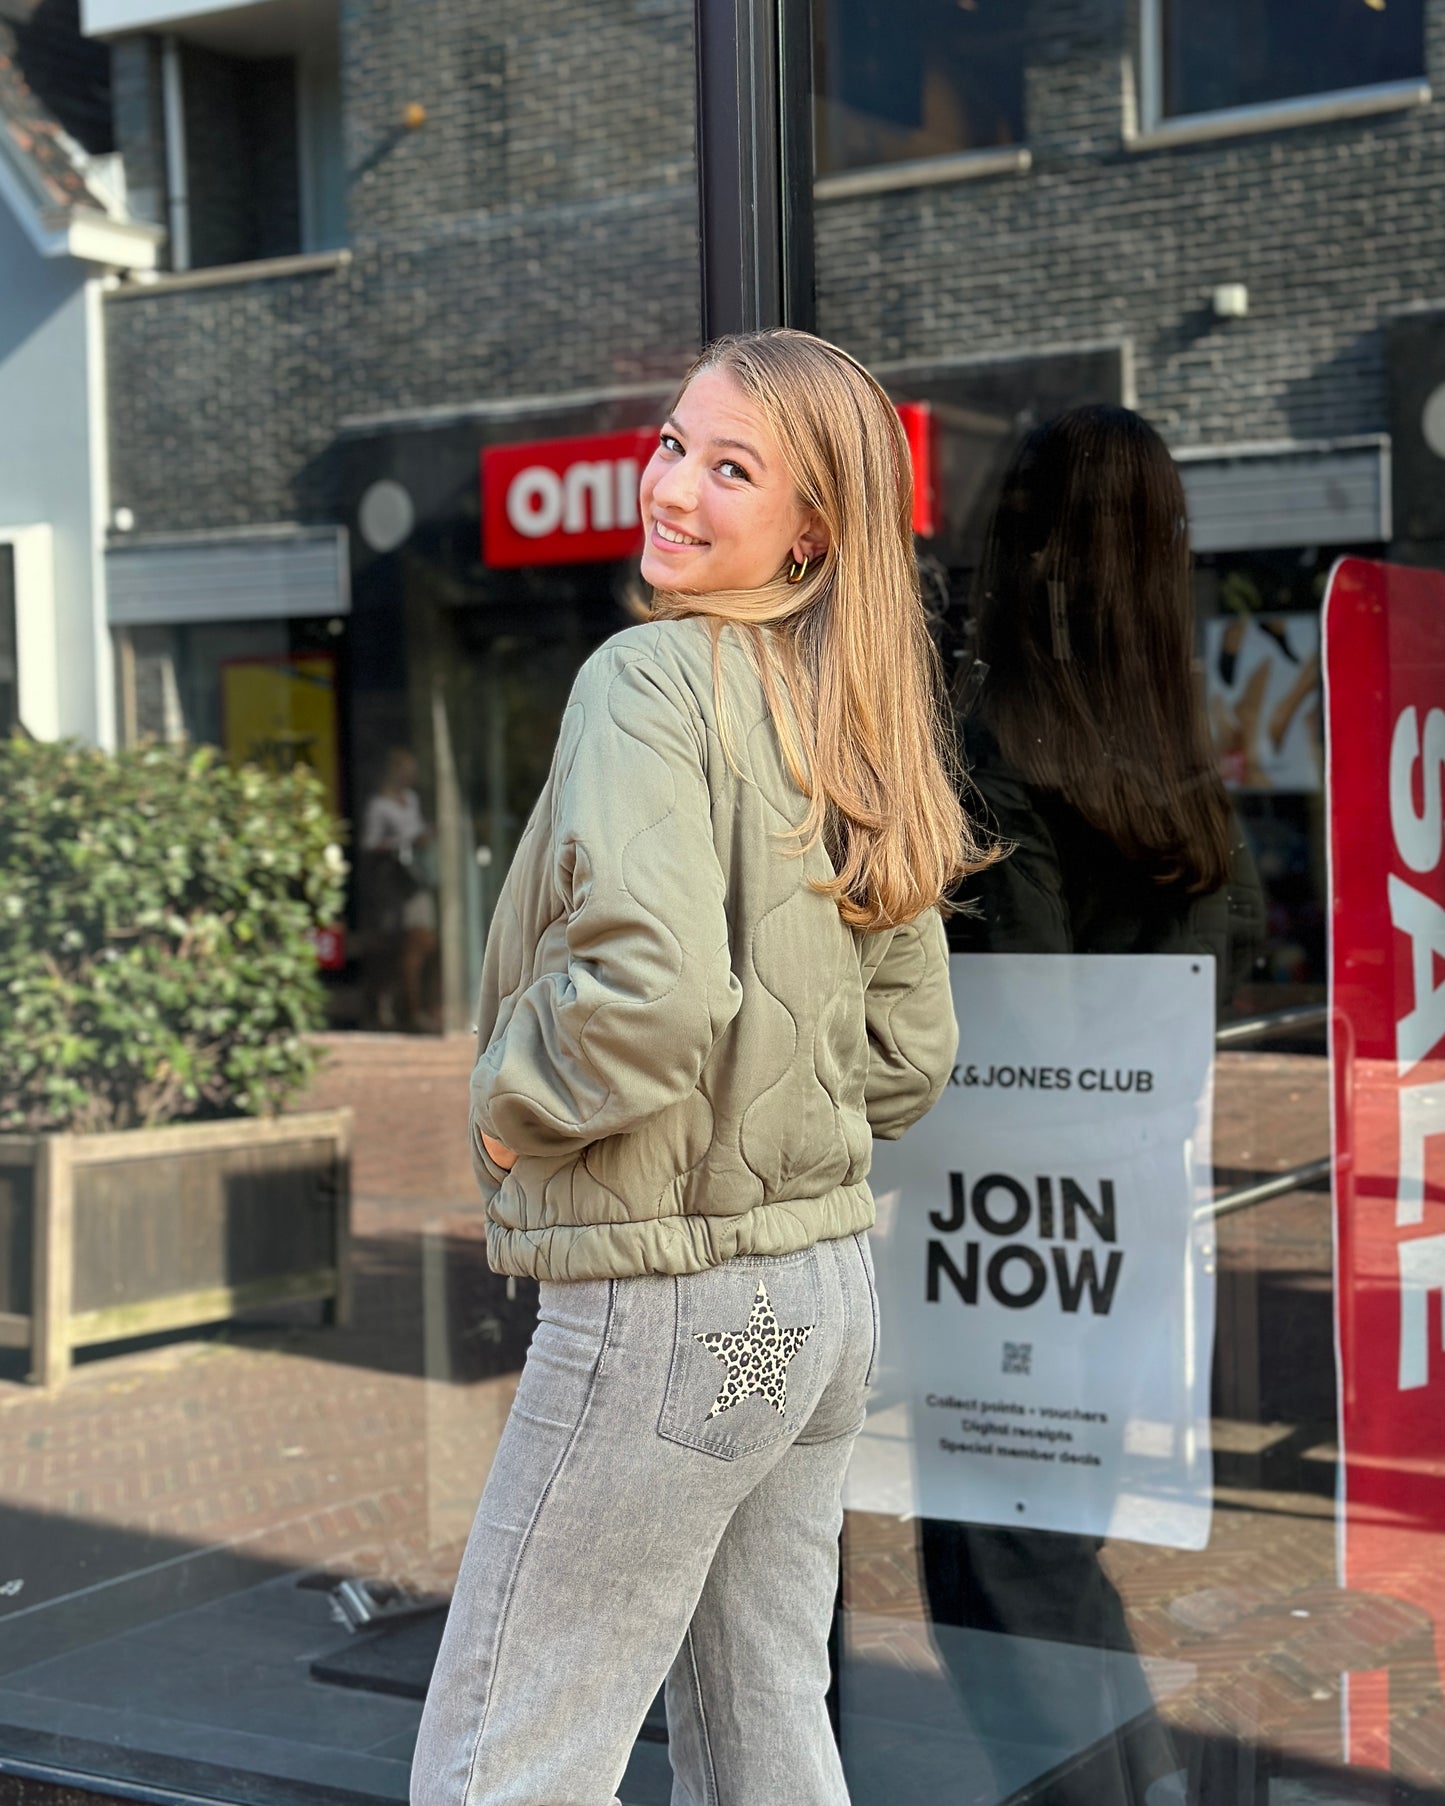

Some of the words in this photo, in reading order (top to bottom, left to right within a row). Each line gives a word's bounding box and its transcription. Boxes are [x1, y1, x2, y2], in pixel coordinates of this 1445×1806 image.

[1078, 1068, 1154, 1093] CLUB
[928, 1170, 1118, 1244] JOIN
[925, 1238, 1124, 1316] NOW
[925, 1393, 977, 1411] Collect
[981, 1398, 1024, 1416] points
[1040, 1406, 1107, 1424] vouchers
[962, 1419, 1008, 1437] Digital
[1013, 1427, 1072, 1444] receipts
[939, 1437, 992, 1455] Special
[997, 1446, 1056, 1462] member
[1059, 1451, 1101, 1467] deals
